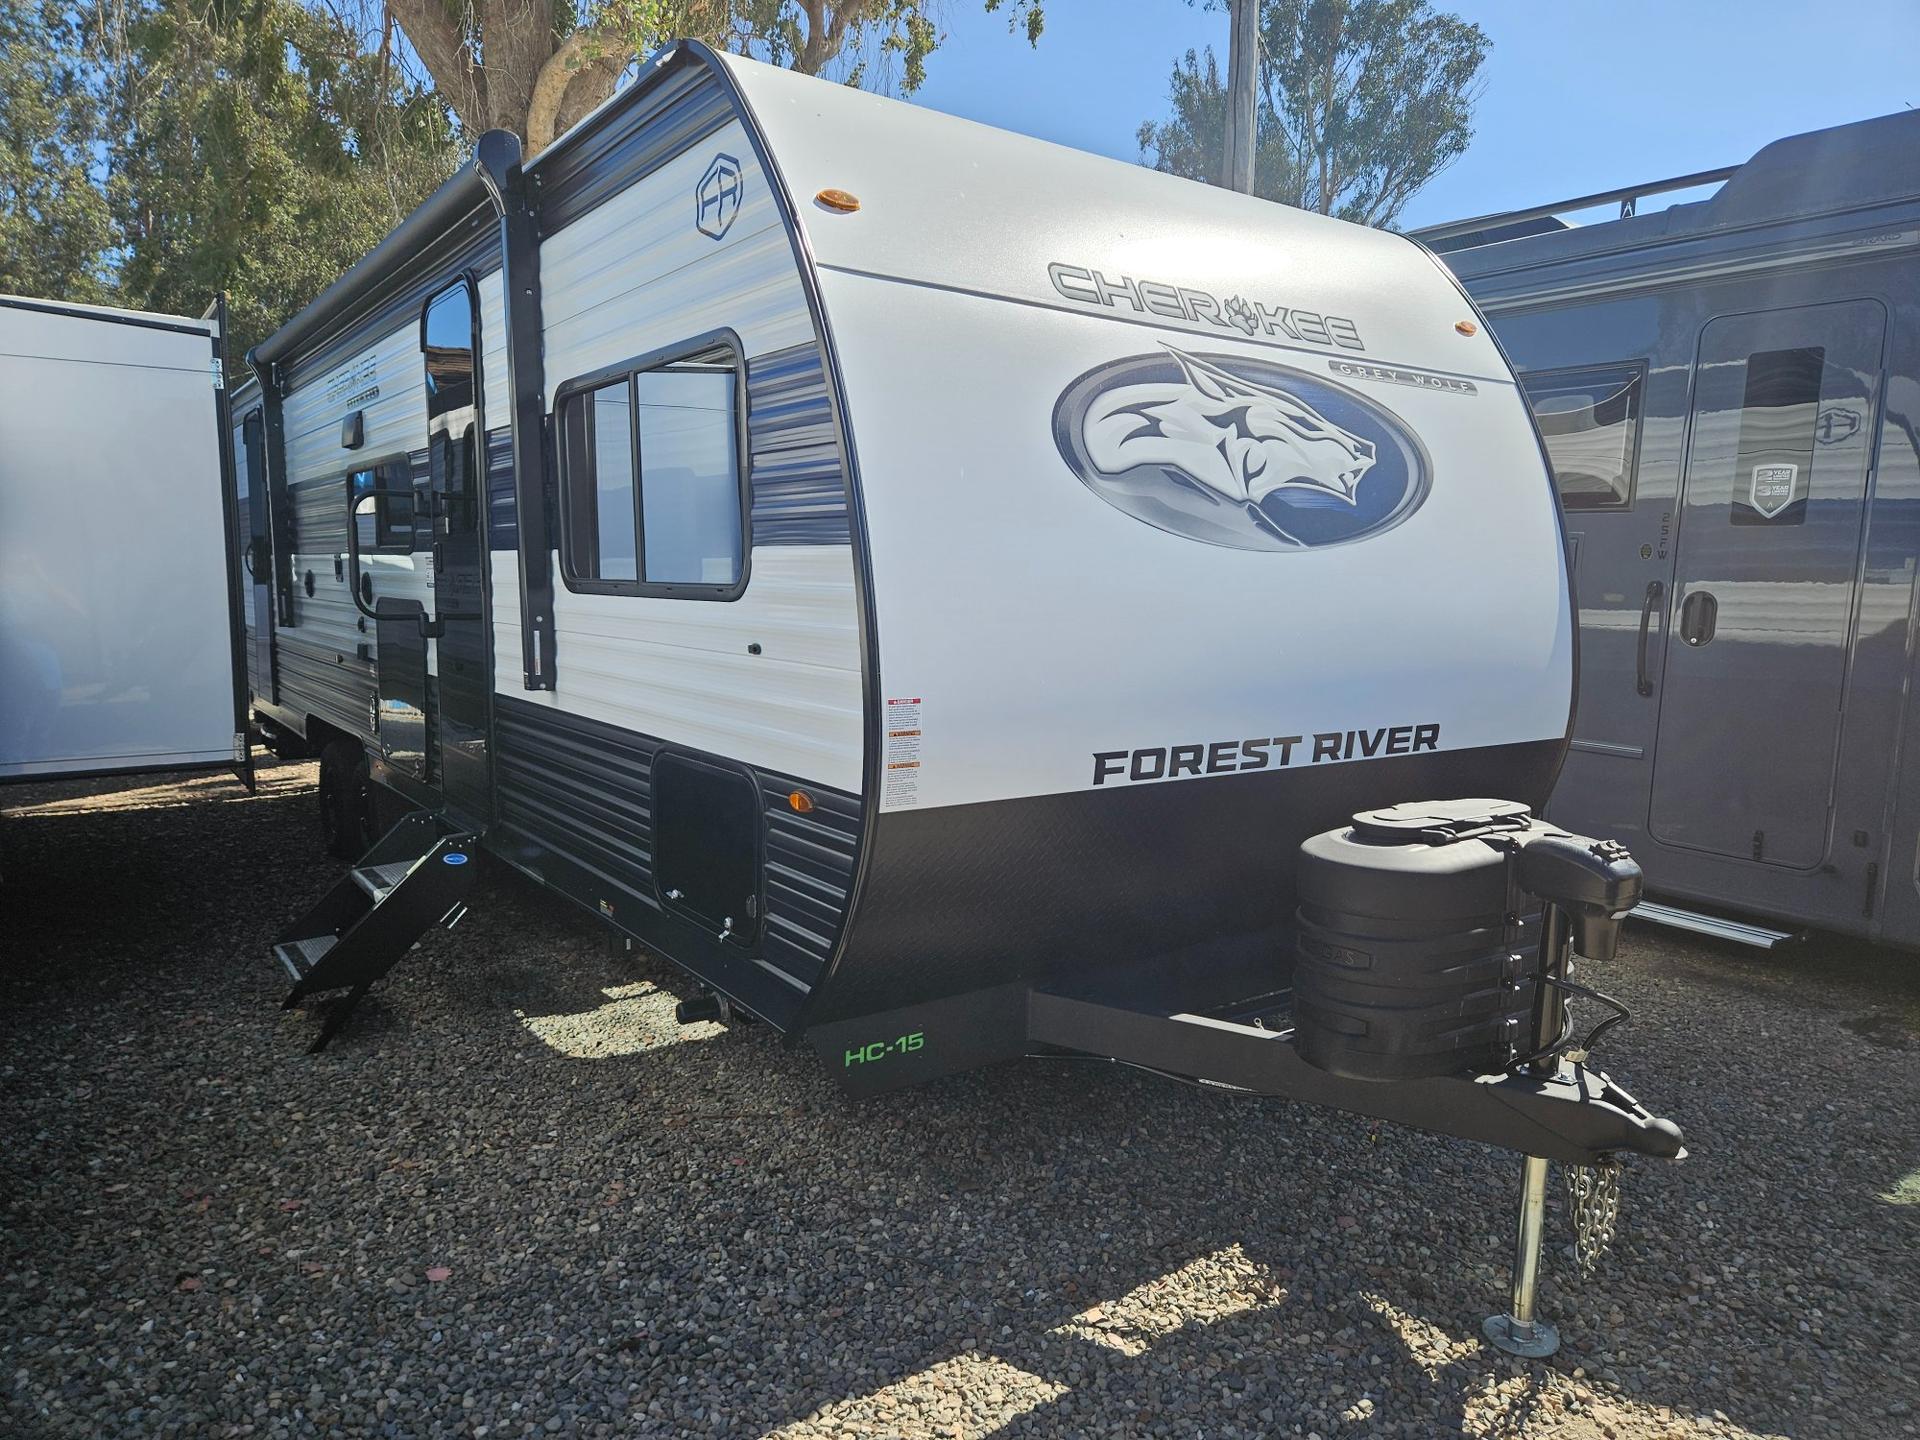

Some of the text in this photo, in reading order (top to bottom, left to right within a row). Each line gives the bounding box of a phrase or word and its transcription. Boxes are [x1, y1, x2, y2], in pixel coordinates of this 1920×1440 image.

[1339, 364, 1469, 393] GREY WOLF
[1757, 470, 1773, 480] 2
[1756, 485, 1771, 496] 3
[1092, 723, 1440, 785] FOREST RIVER
[844, 1032, 924, 1067] HC-15
